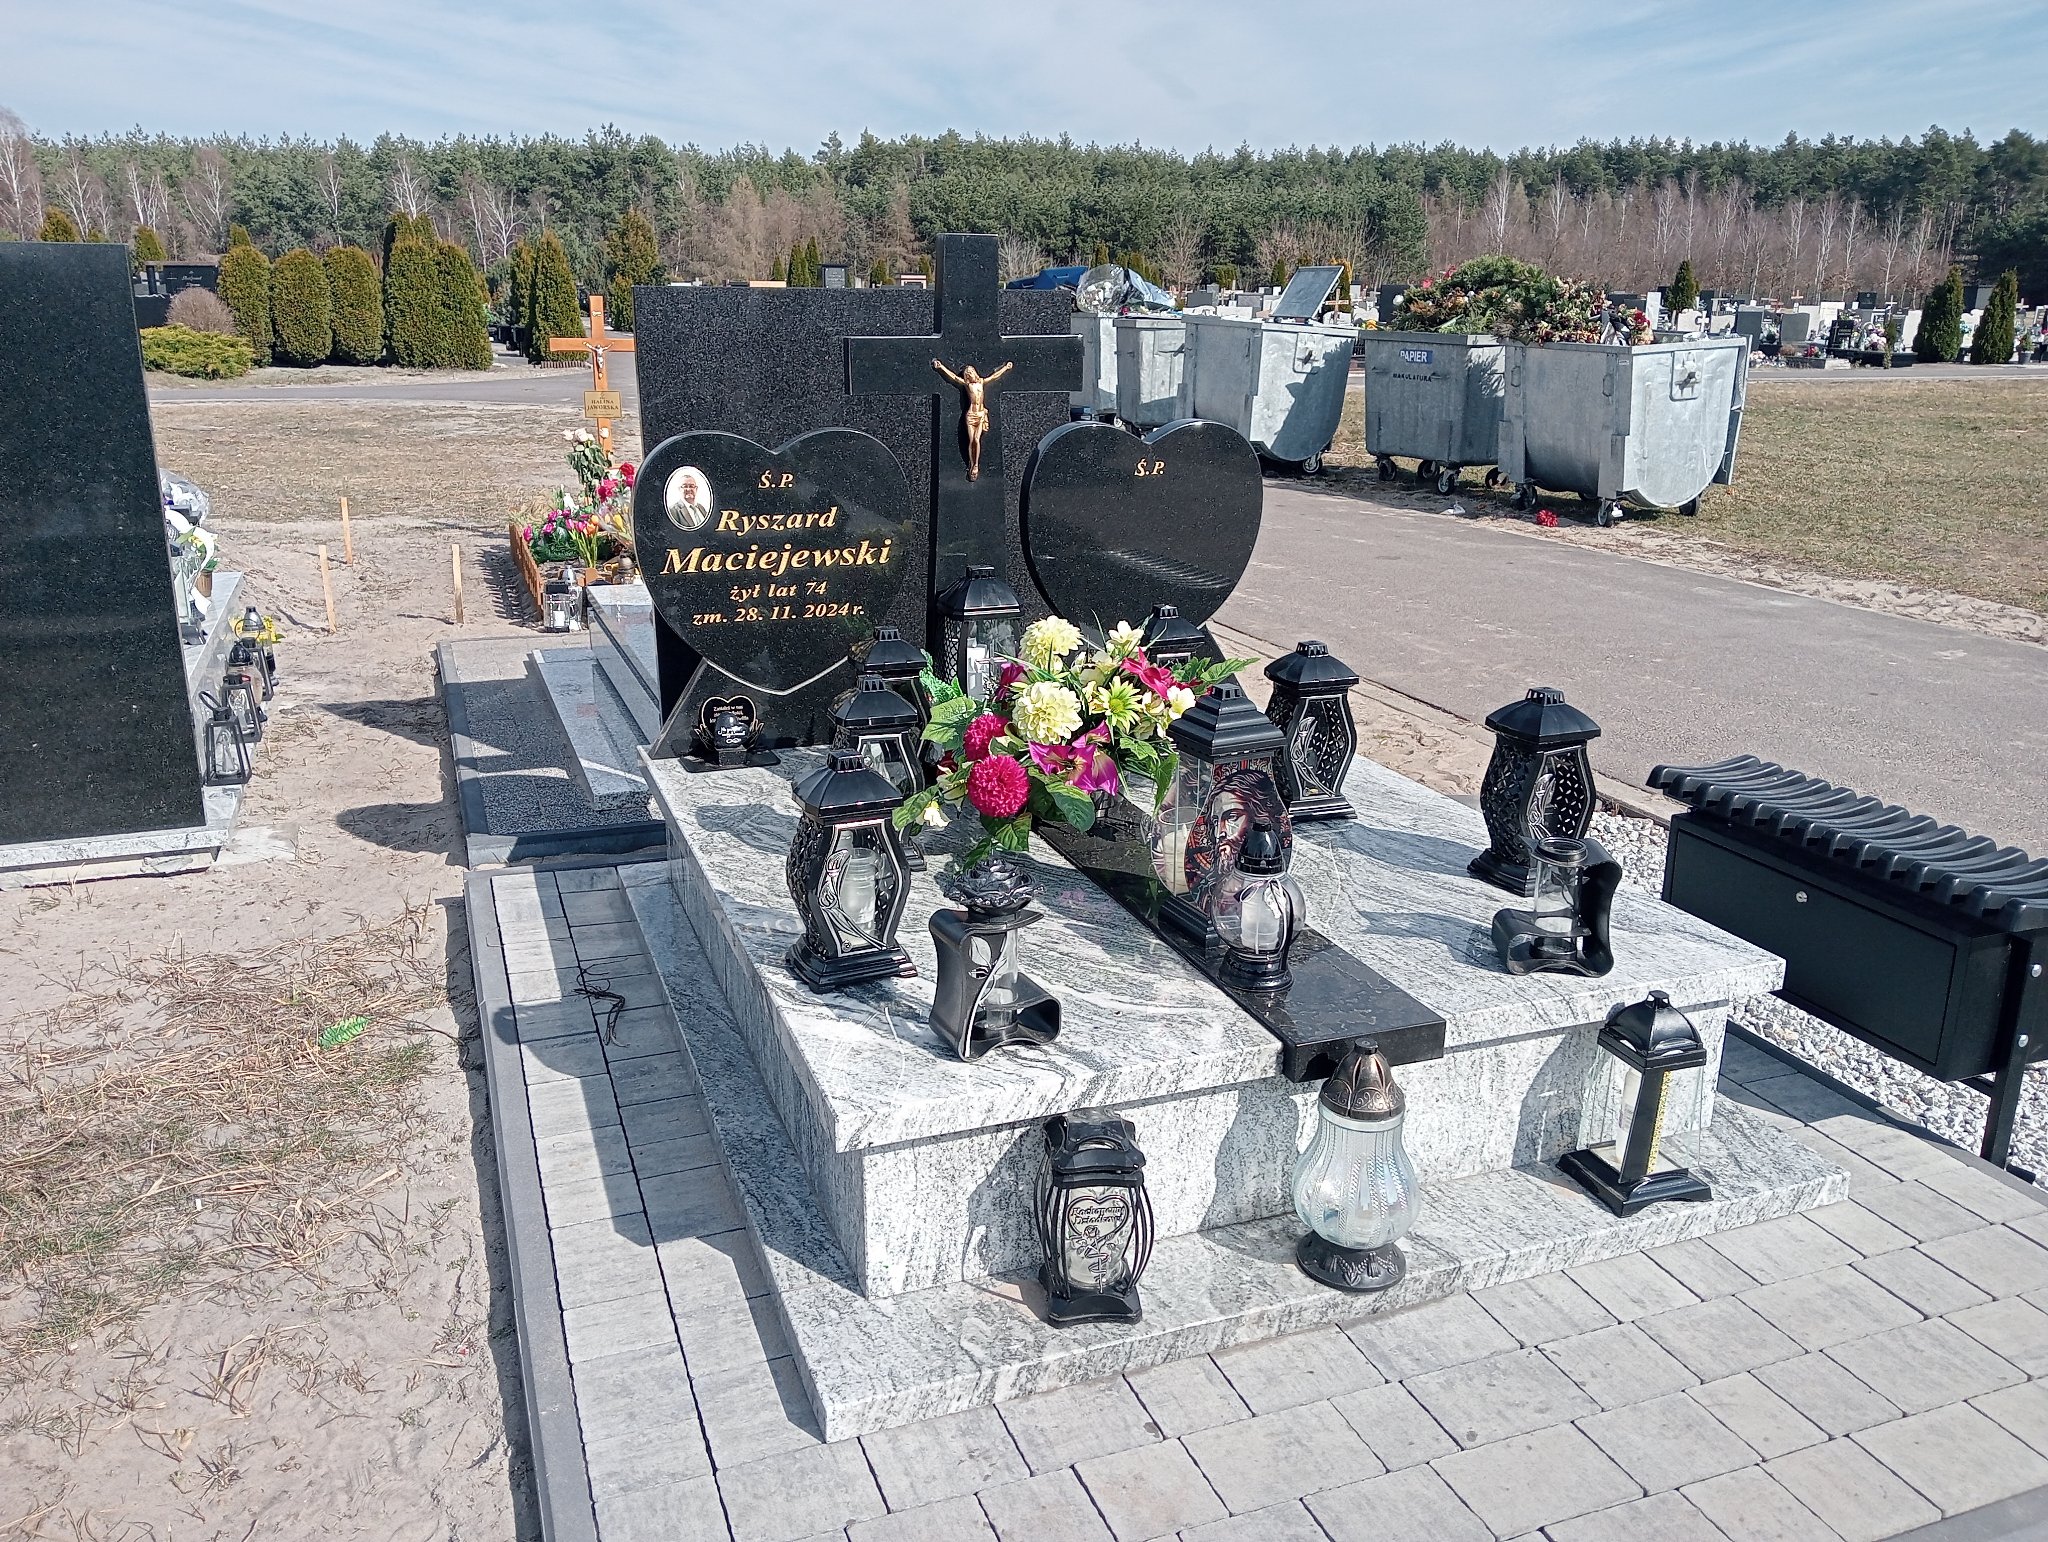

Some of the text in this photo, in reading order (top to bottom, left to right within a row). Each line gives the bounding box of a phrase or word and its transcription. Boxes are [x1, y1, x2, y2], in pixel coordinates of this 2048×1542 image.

[1400, 350, 1428, 363] PAPIER
[715, 506, 838, 537] Ryszard
[660, 538, 893, 577] Maciejewski
[730, 580, 828, 603] żył lat 74
[692, 613, 728, 626] zm.
[734, 606, 764, 623] 28.
[769, 605, 797, 620] 11.
